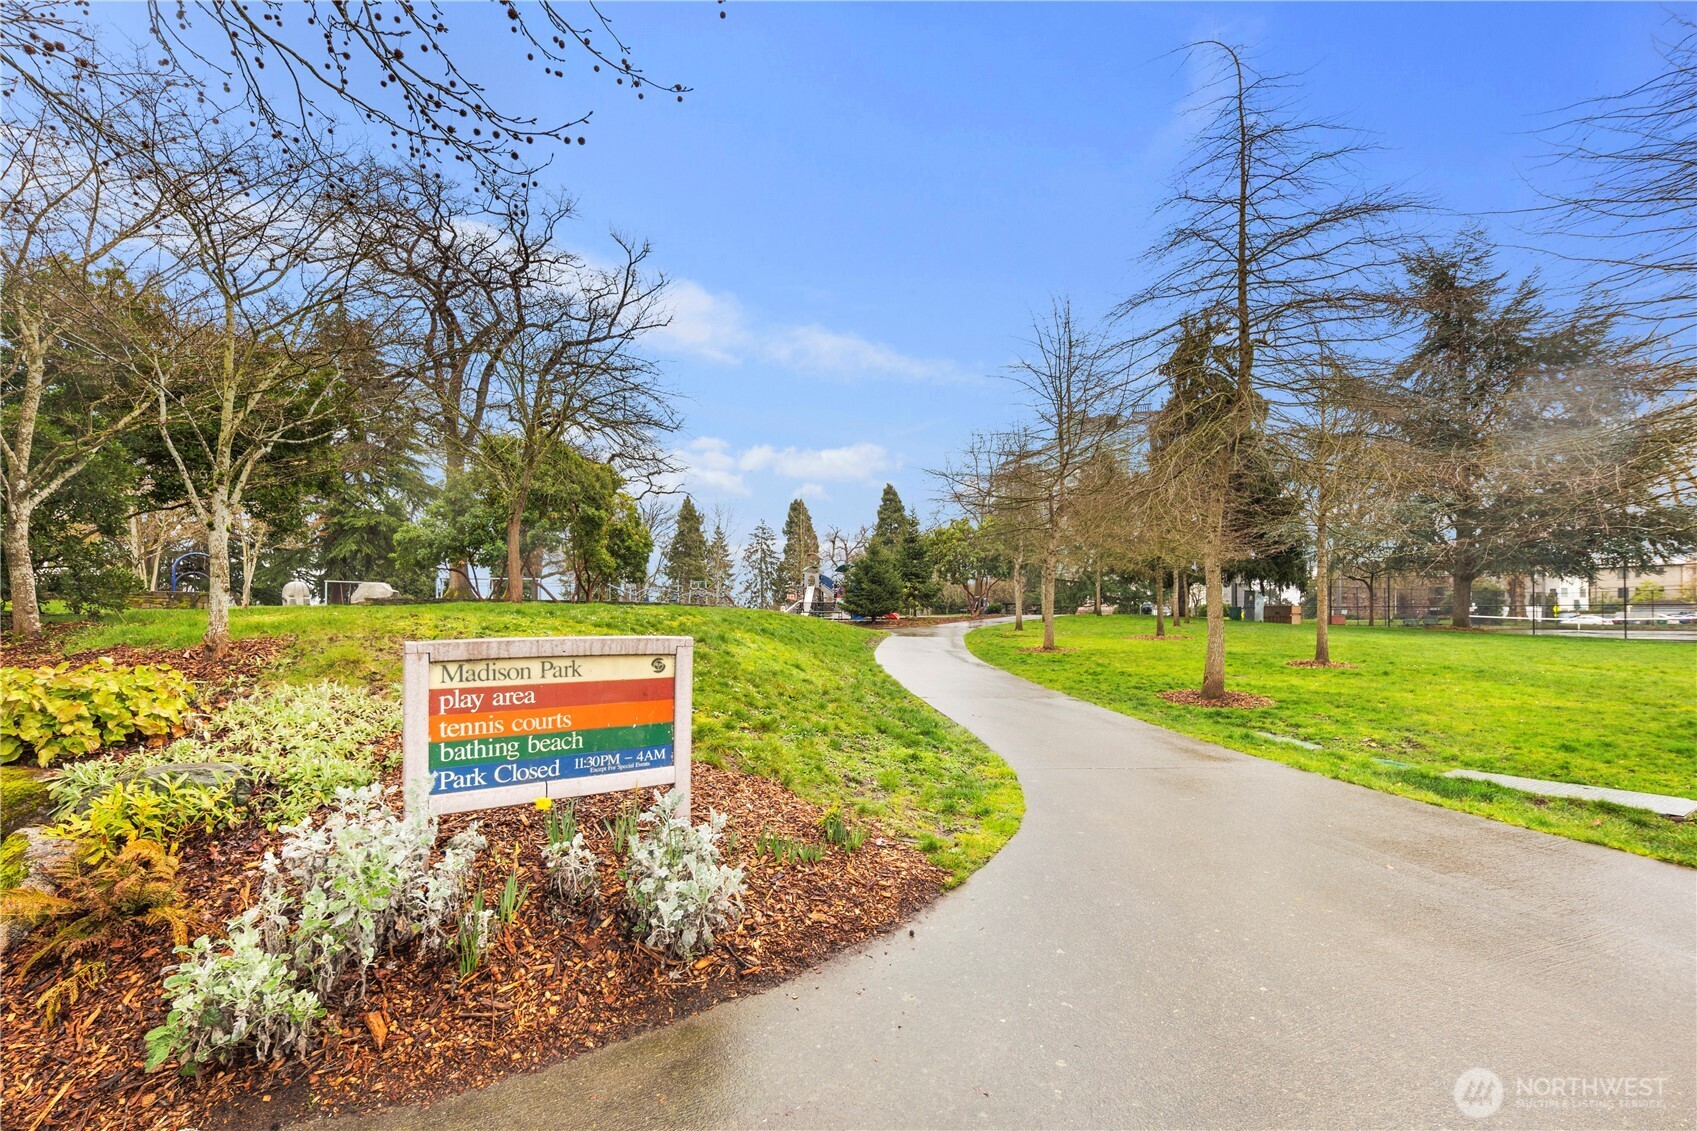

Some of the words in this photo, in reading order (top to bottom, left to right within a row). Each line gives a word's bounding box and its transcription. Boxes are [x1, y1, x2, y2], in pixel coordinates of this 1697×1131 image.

[440, 662, 531, 684] Madison
[540, 660, 582, 679] Park
[439, 689, 485, 715] play
[492, 690, 536, 706] area
[439, 715, 504, 738] tennis
[511, 713, 572, 732] courts
[439, 738, 520, 762] bathing
[528, 731, 583, 753] beach
[438, 768, 487, 791] Park
[494, 759, 560, 783] Closed
[574, 753, 620, 770] 11:30PM
[636, 748, 666, 762] 4AM
